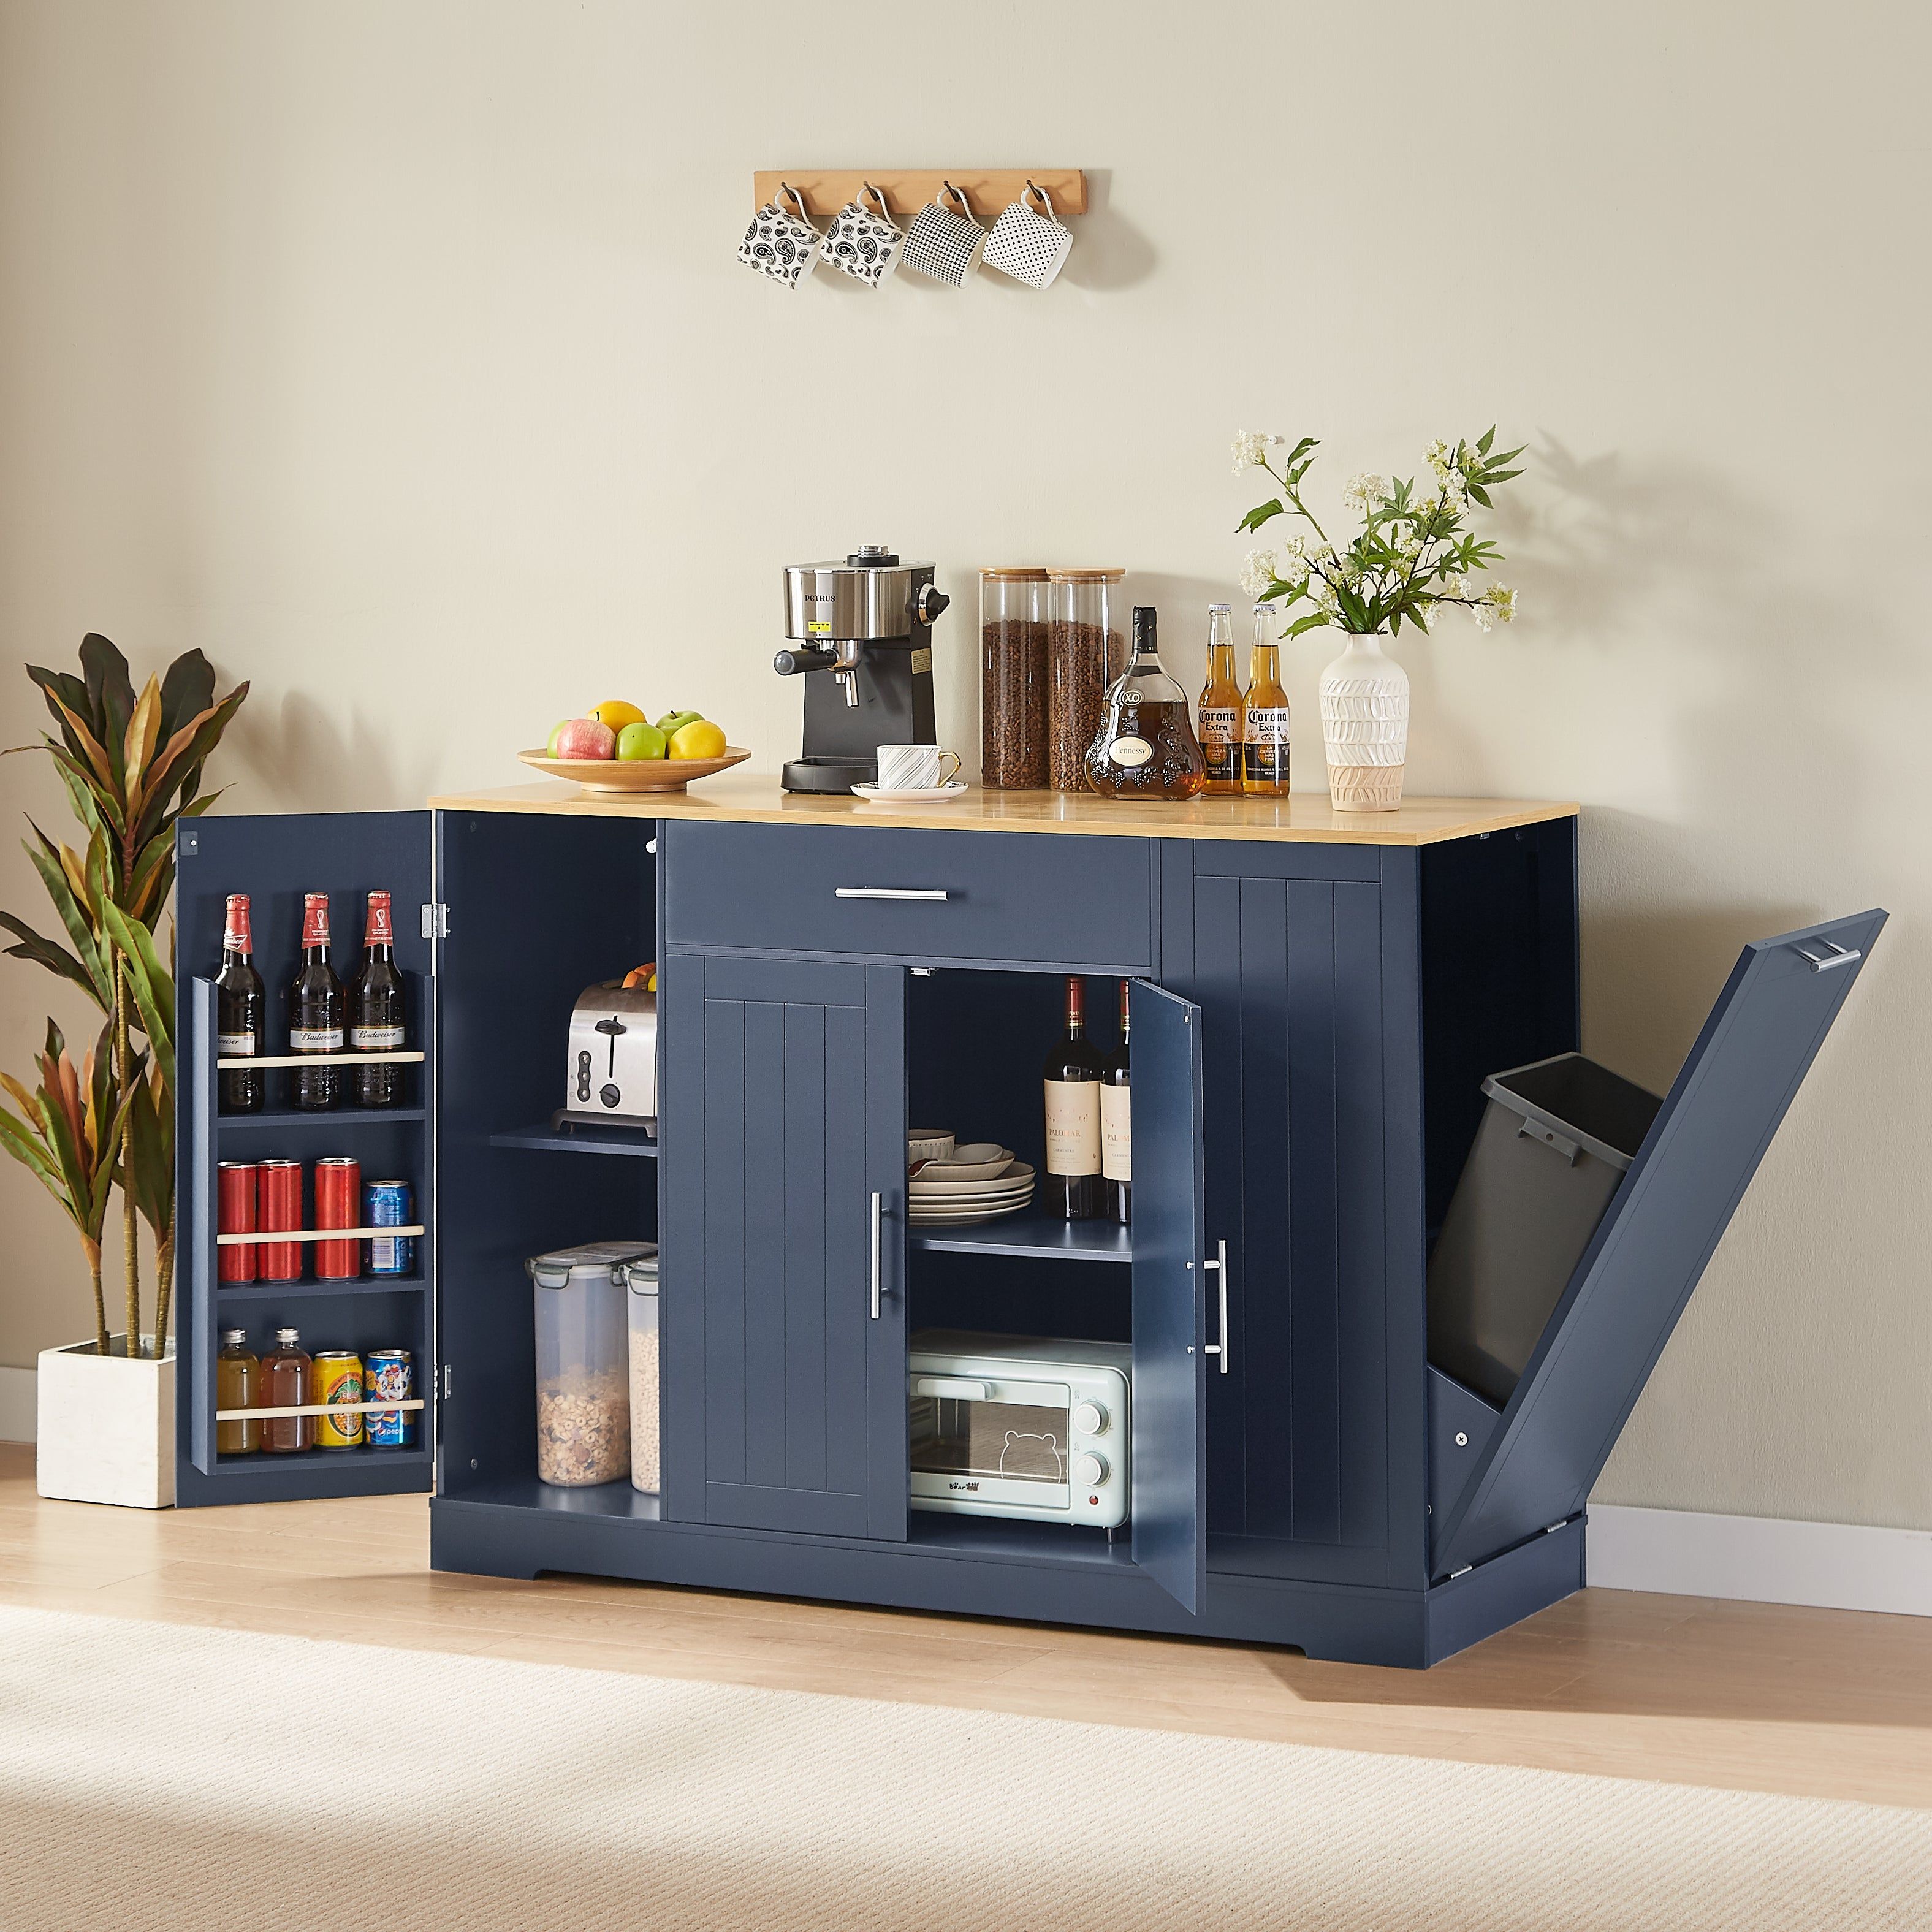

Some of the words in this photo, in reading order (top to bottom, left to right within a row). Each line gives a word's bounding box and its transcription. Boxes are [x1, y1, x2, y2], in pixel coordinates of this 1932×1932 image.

[1199, 709, 1236, 724] Corona
[1248, 710, 1287, 725] Corona
[1206, 722, 1228, 731] Extra
[1258, 723, 1281, 731] Extra
[1115, 747, 1146, 755] Hennessy
[301, 1032, 338, 1041] Budweiser
[359, 1030, 396, 1038] Budweiser
